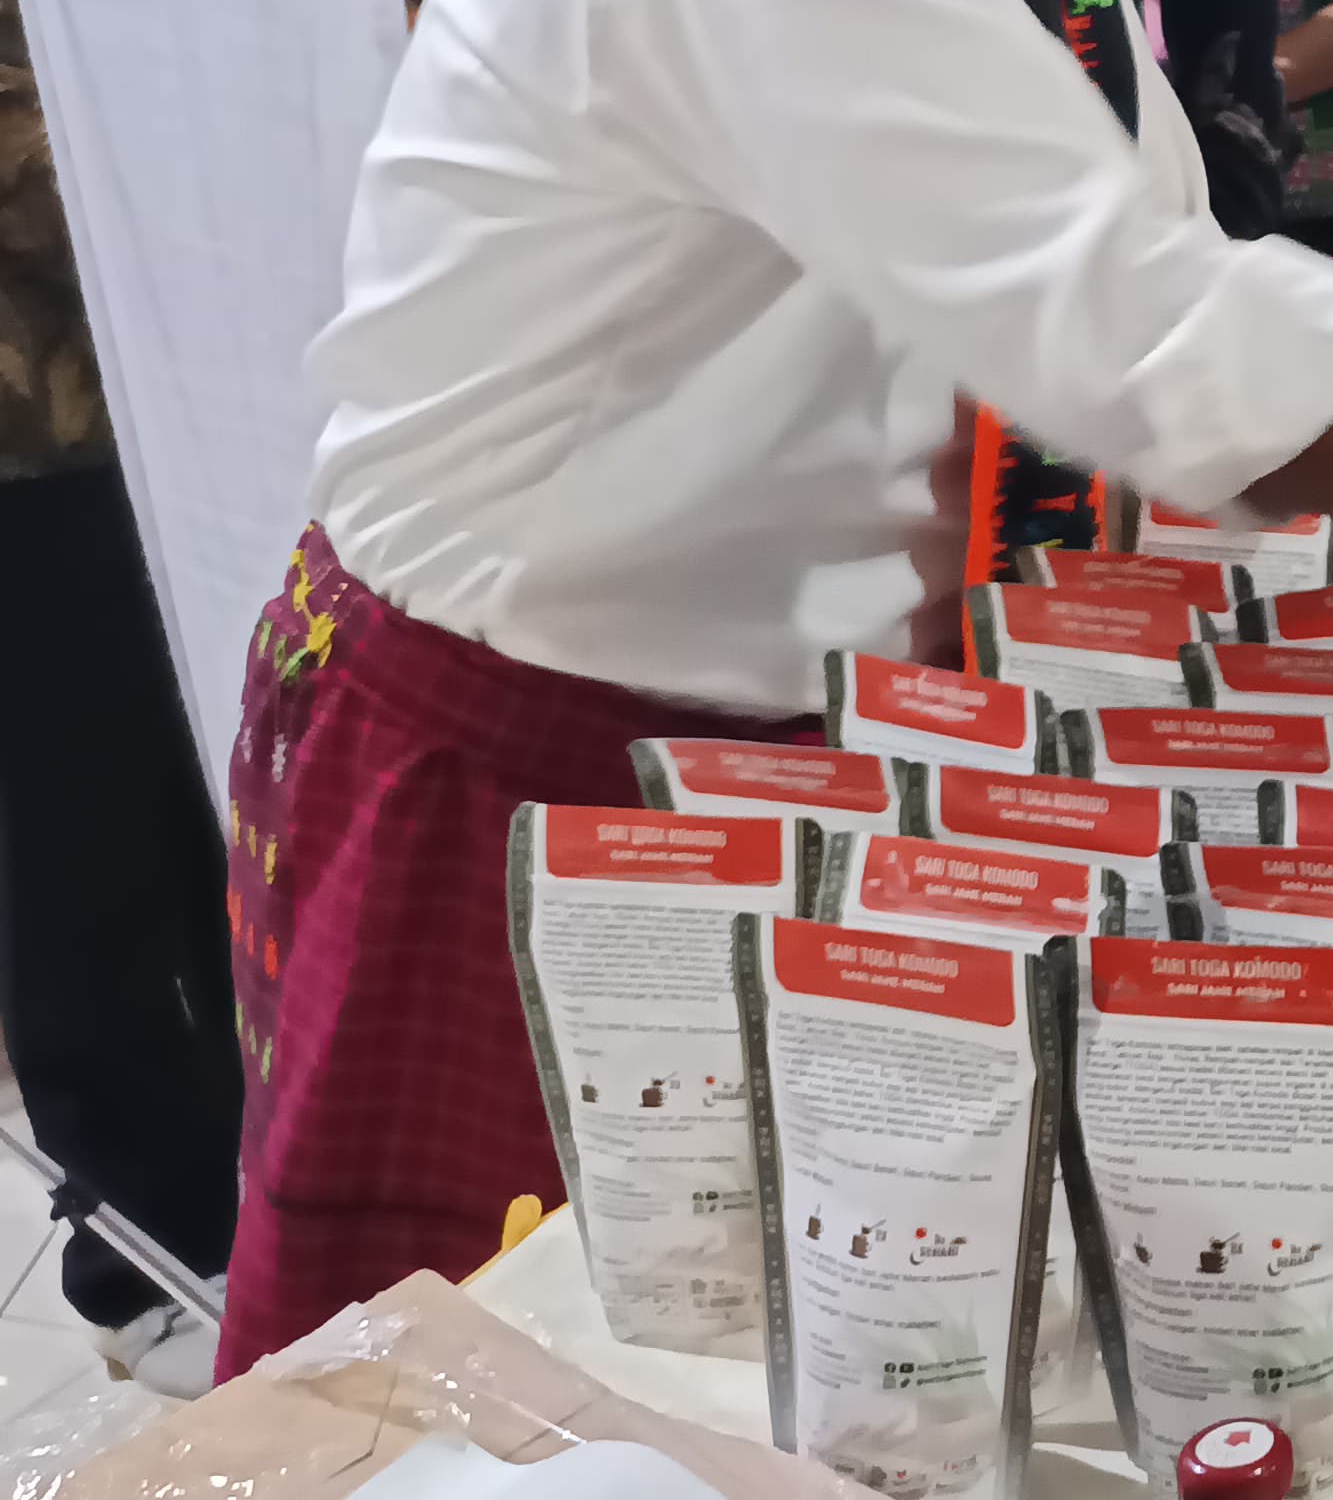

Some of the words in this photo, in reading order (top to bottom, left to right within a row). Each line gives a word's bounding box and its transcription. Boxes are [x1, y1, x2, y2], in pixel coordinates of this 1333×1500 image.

[1152, 957, 1184, 974] SARI
[1190, 959, 1229, 977] TOGA
[1234, 960, 1300, 980] KOMODO
